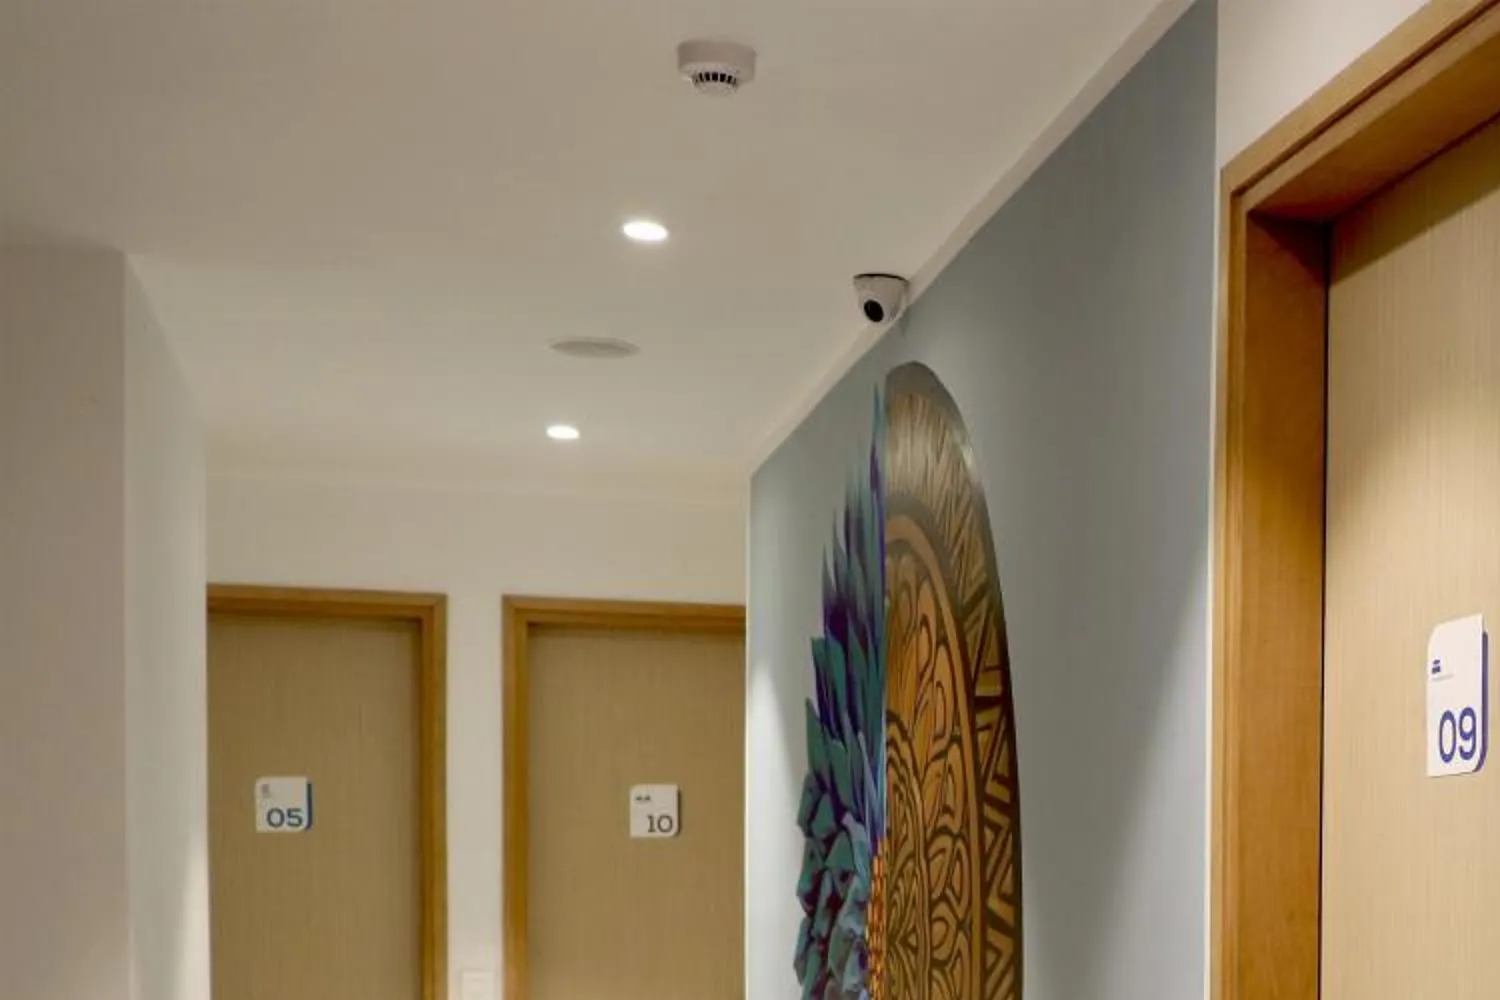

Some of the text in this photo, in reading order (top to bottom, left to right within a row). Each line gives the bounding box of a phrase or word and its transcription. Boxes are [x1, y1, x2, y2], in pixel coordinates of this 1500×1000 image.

[1439, 706, 1477, 764] 09
[266, 807, 303, 828] 05
[647, 814, 673, 833] 10
